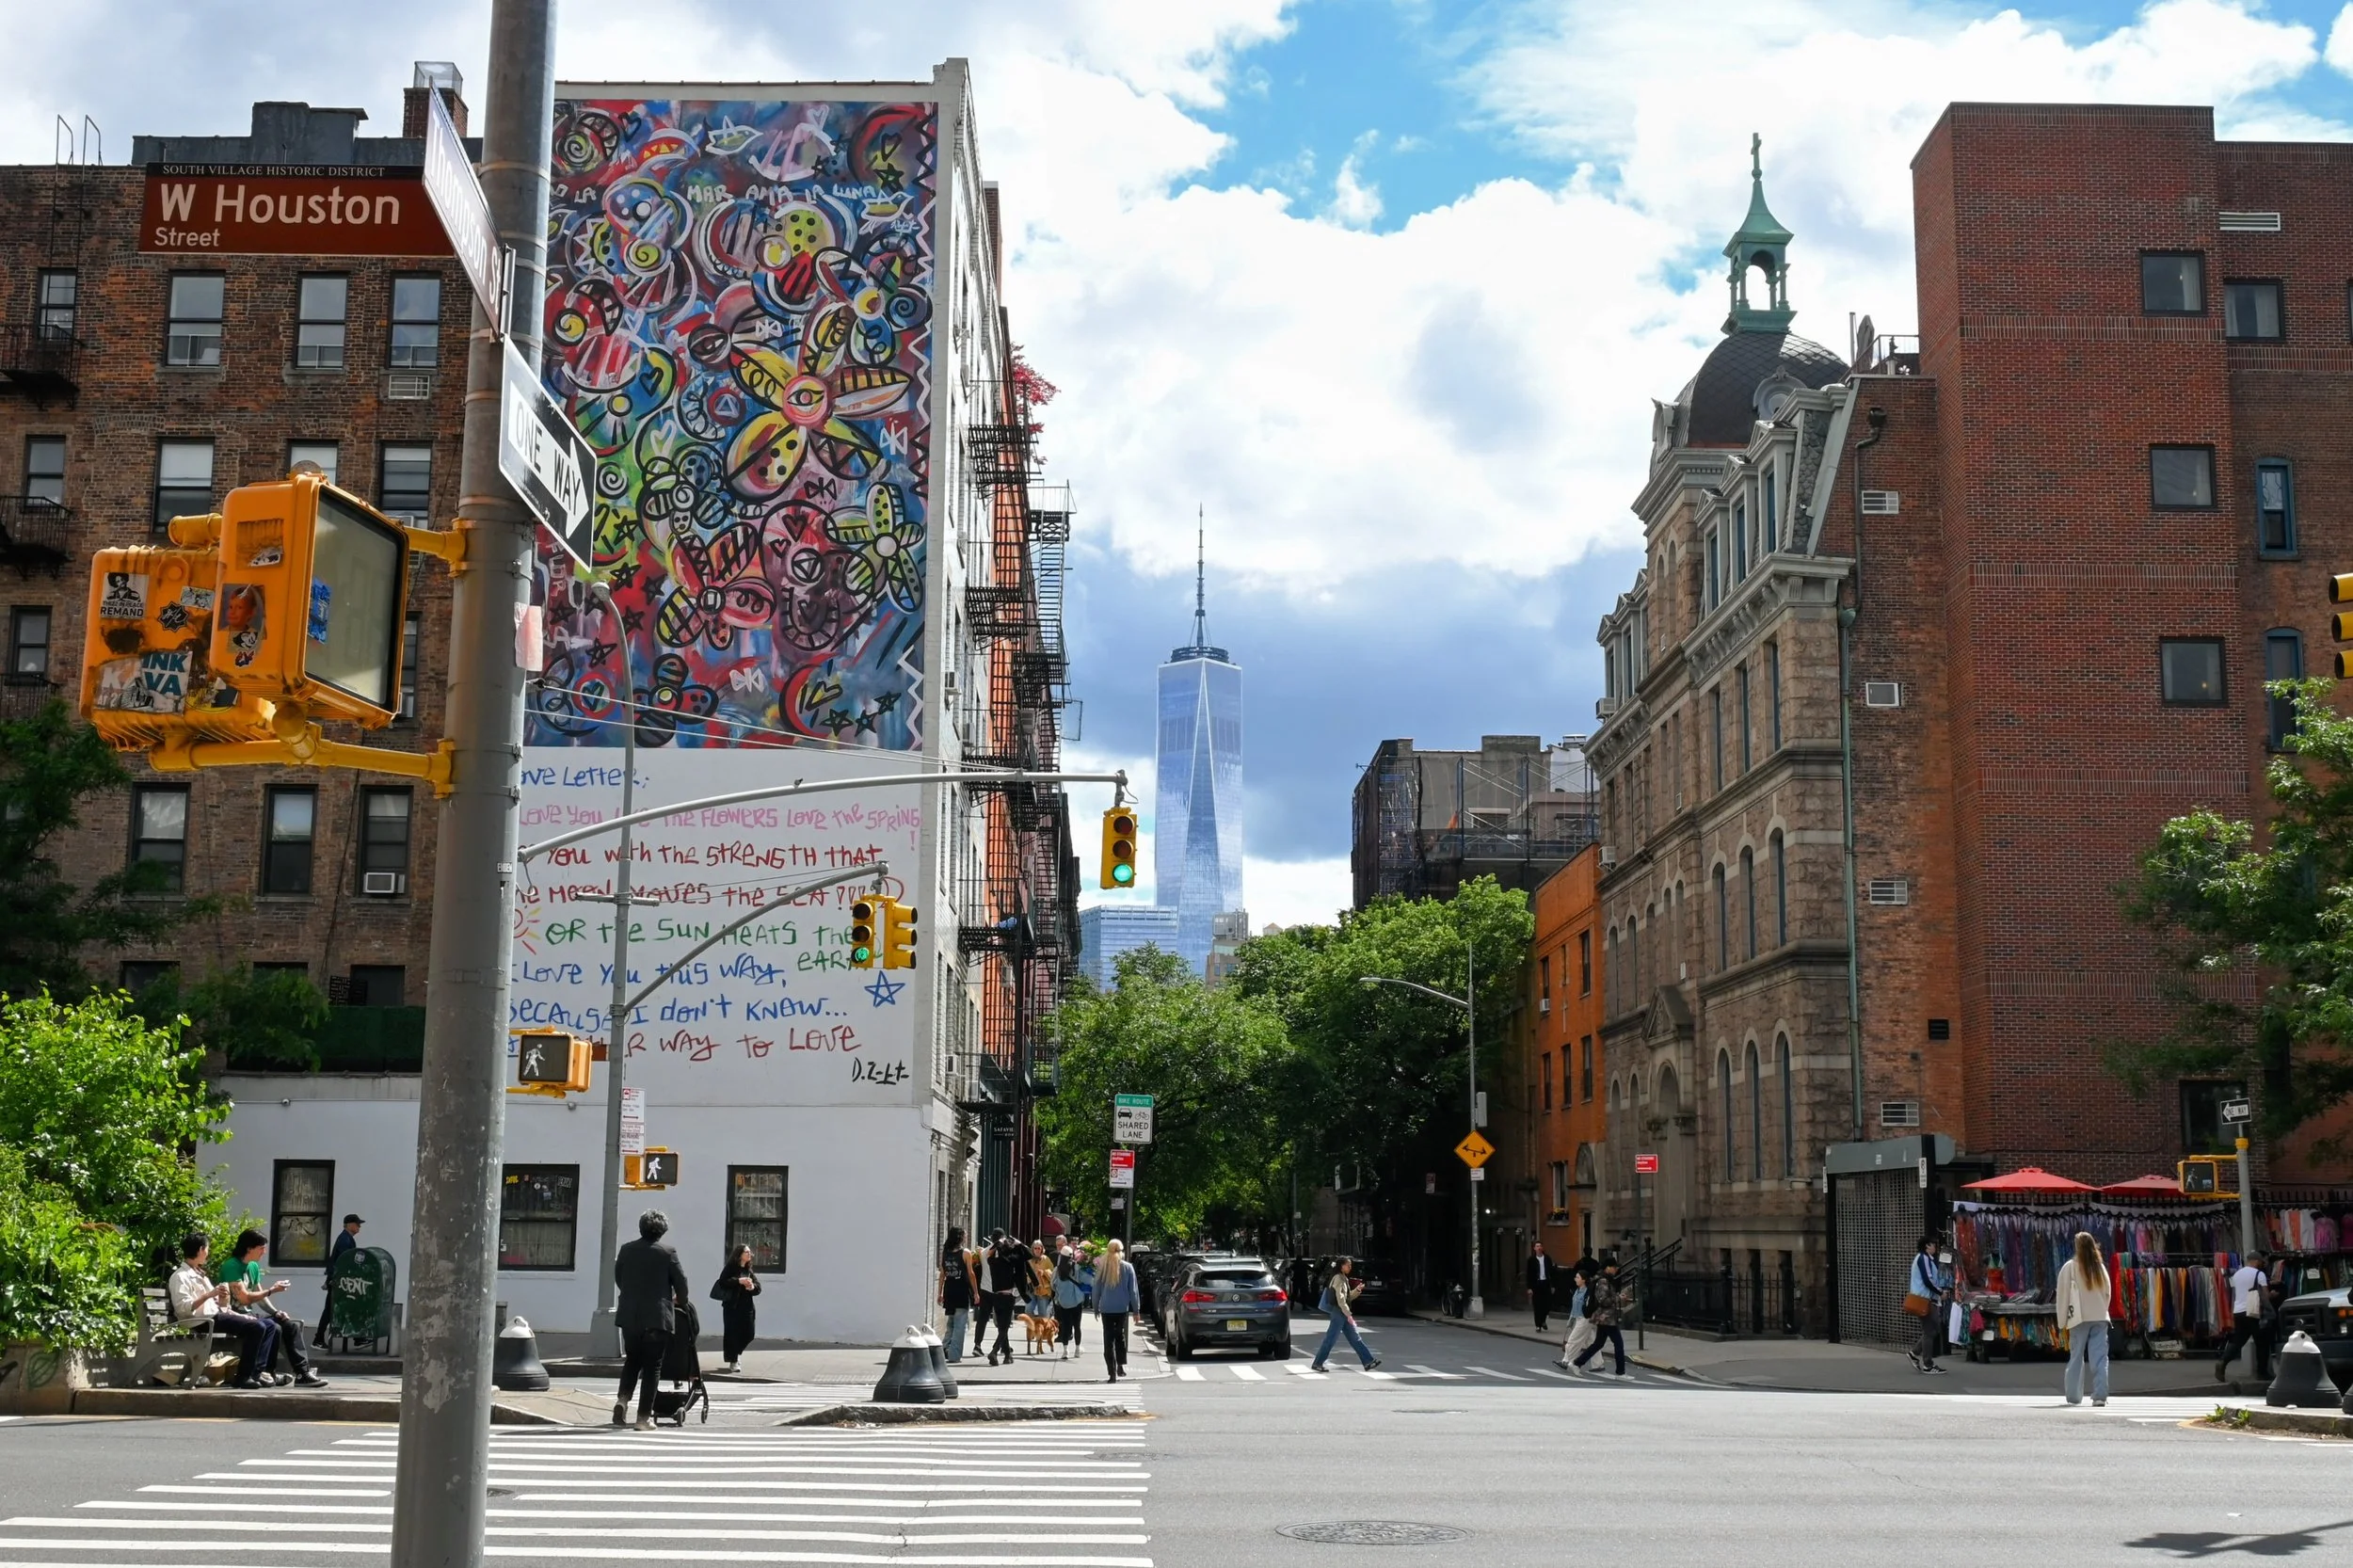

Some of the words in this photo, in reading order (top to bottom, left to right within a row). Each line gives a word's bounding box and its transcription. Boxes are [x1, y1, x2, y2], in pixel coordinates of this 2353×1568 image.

[163, 165, 204, 175] SOUTH
[209, 166, 263, 176] VILLAGE
[266, 166, 325, 176] HISTORIC
[329, 167, 385, 177] DISTRICT
[686, 184, 734, 203] MAR
[161, 184, 196, 222] W
[215, 184, 400, 225] Houston
[430, 109, 488, 286] Thompson
[488, 246, 502, 316] St
[154, 227, 220, 248] Street
[517, 401, 542, 473] ONE
[553, 449, 582, 517] WAY
[101, 606, 144, 616] REMAND
[1132, 1097, 1150, 1106] ROUTE
[1117, 1121, 1149, 1130] SHARED
[1122, 1130, 1144, 1139] LANE
